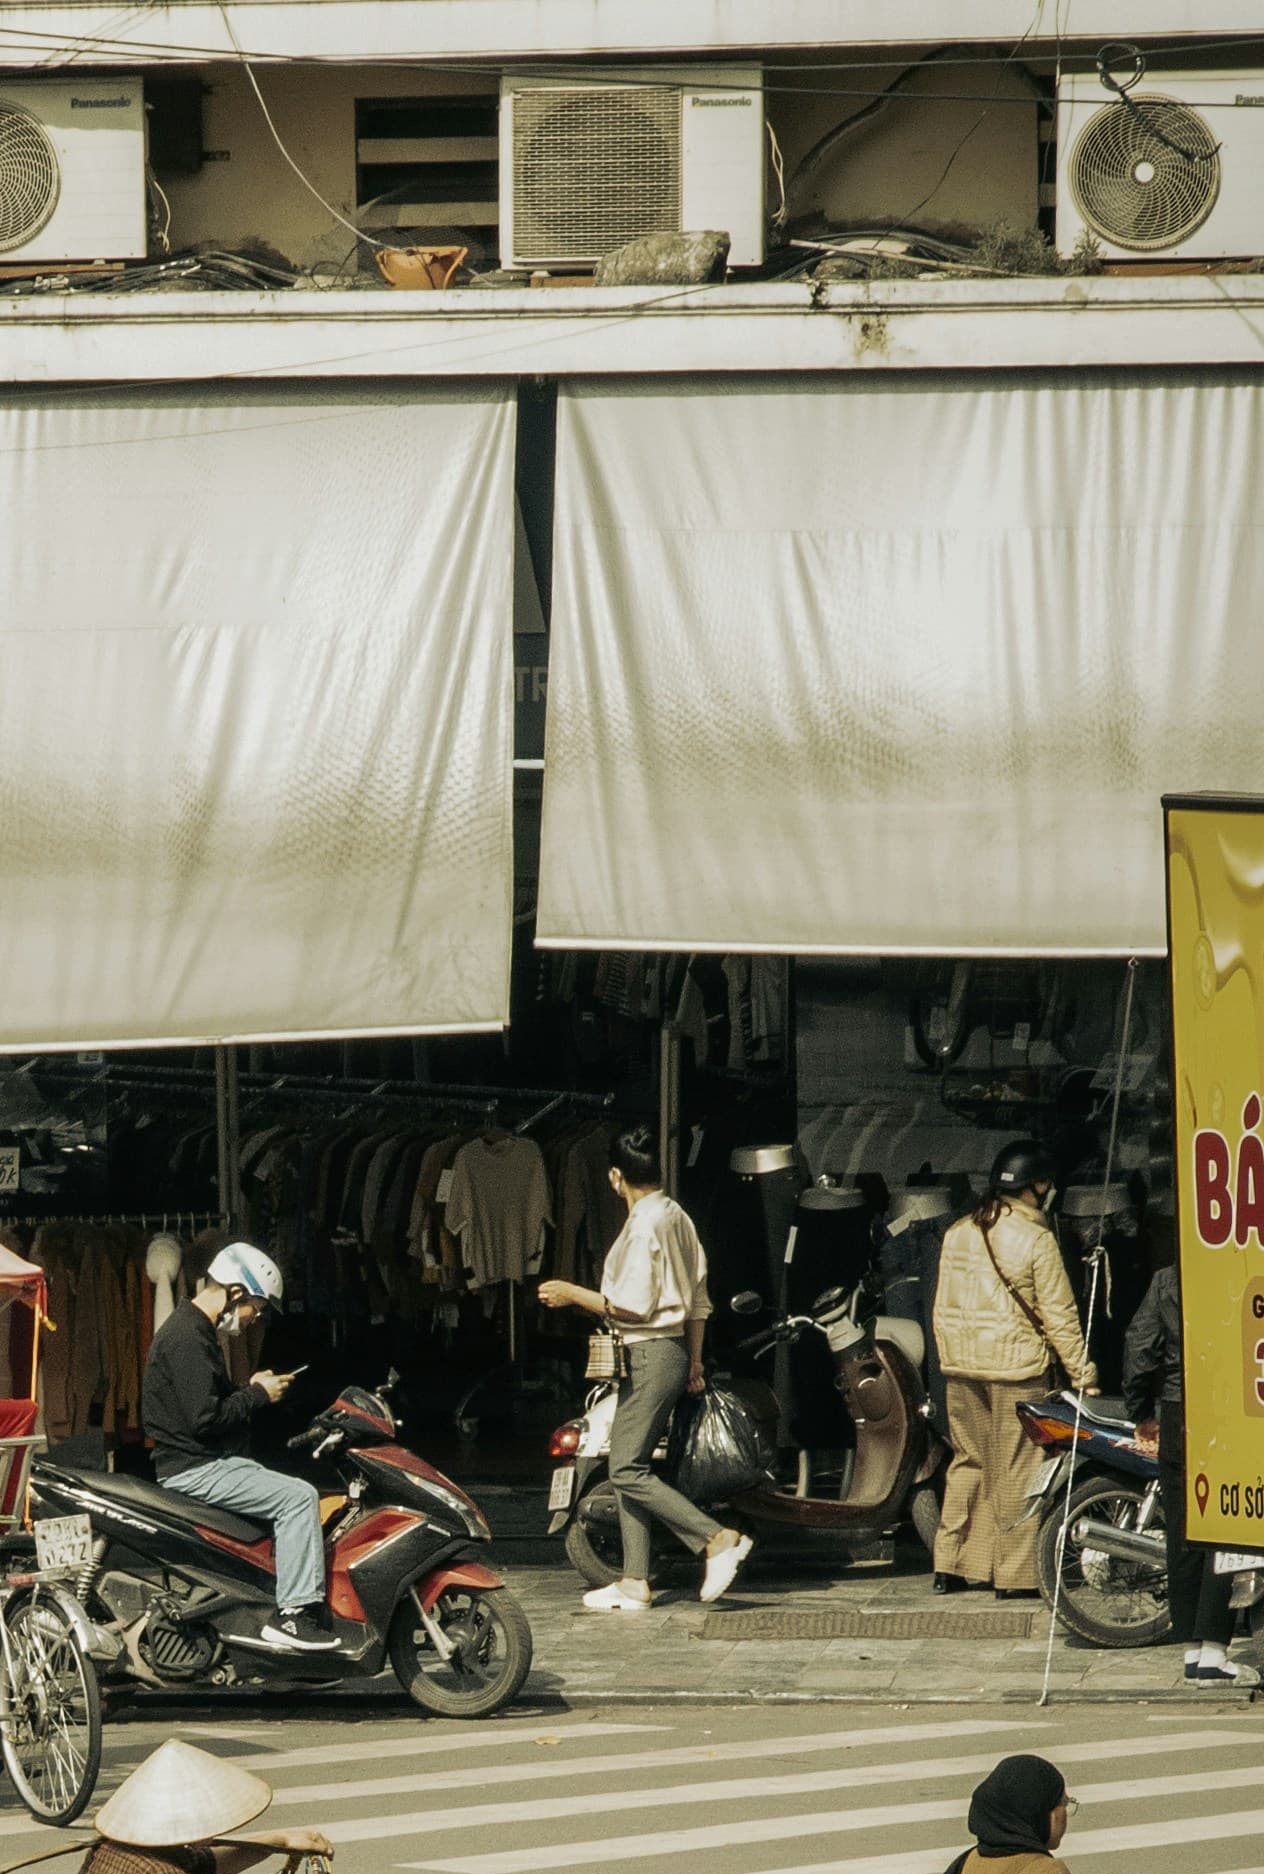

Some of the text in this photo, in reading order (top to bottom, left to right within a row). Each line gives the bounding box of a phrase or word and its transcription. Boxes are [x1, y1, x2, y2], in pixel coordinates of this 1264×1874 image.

[71, 97, 131, 108] Panasonic
[691, 96, 752, 107] Panasonic
[1220, 1475, 1264, 1520] CƠ SỞ
